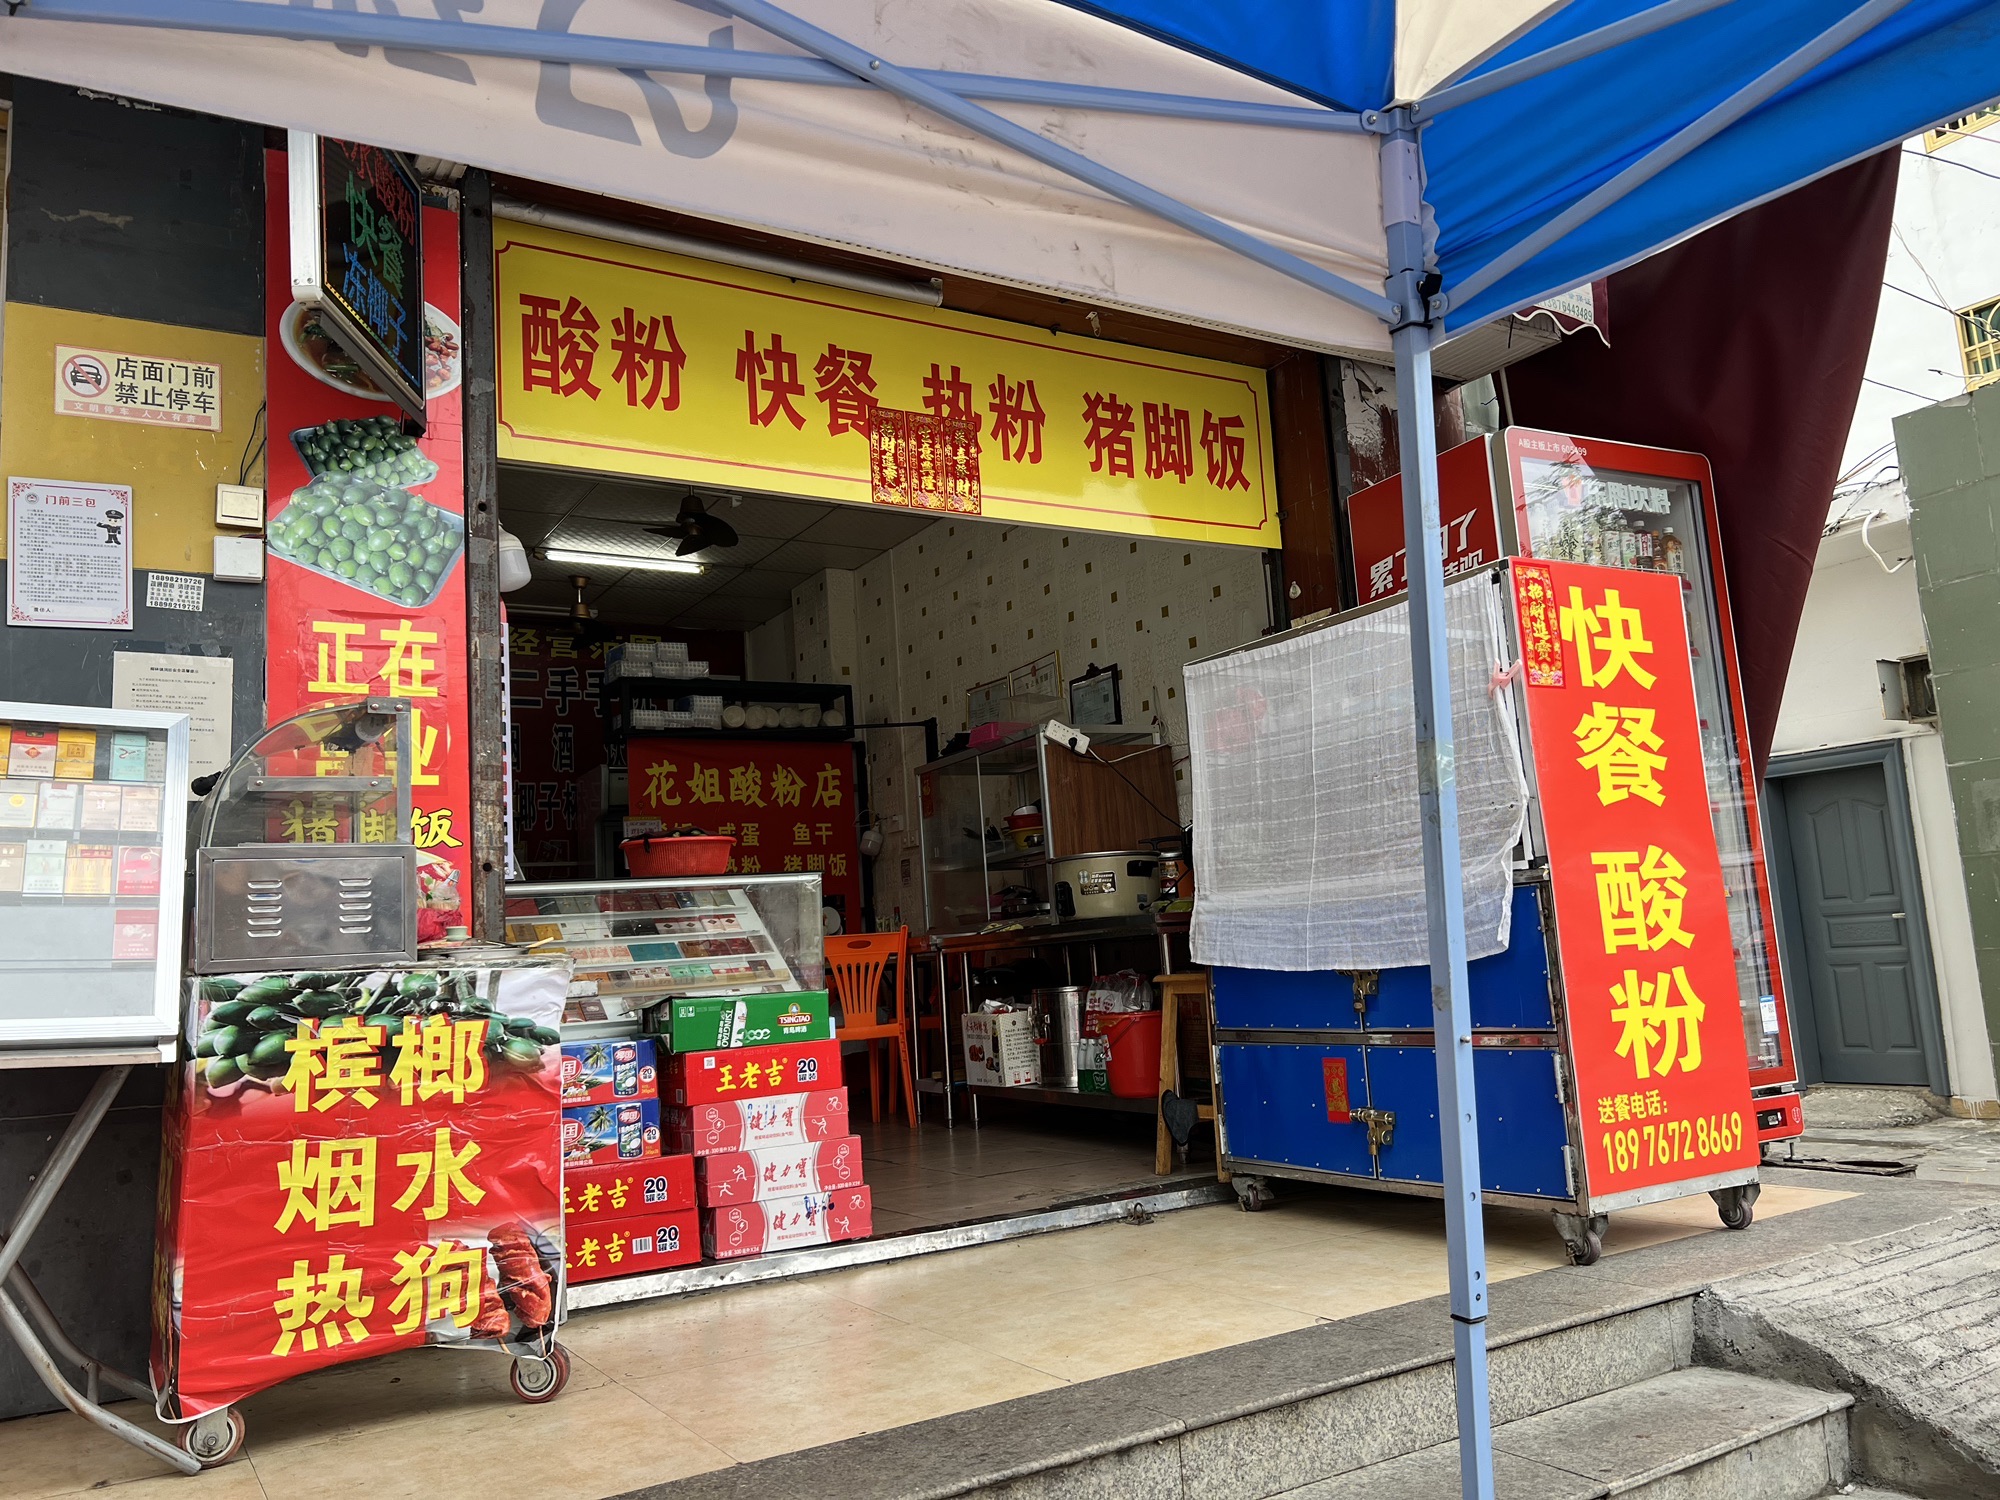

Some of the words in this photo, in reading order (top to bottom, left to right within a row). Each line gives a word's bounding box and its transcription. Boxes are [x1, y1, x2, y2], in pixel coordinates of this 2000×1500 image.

[346, 170, 405, 300] 快餐
[114, 357, 215, 389] 店面门前
[114, 382, 215, 413] 禁止停车
[520, 293, 687, 411] 酸粉
[735, 329, 878, 438] 快餐
[922, 361, 1046, 465] 热粉
[1081, 390, 1252, 493] 猪脚饭
[74, 402, 130, 416] 文明停车
[142, 409, 196, 423] 人人有责
[1518, 438, 1560, 453] A股主板上市
[1561, 445, 1588, 456] 605499
[45, 494, 96, 508] 门前三包
[151, 574, 203, 585] 18898219726
[149, 601, 201, 610] 18898219726
[308, 619, 439, 698] 正在
[1560, 585, 1669, 808] 快餐
[643, 759, 843, 808] 花姐酸粉店
[792, 822, 834, 846] 鱼干
[783, 852, 848, 877] 猪脚饭
[1590, 844, 1706, 1080] 酸粉
[721, 1009, 734, 1048] TSINGTAO
[778, 1014, 811, 1025] TSINGTAO
[783, 1026, 808, 1035] 青岛啤酒
[282, 1012, 490, 1113] 槟榔
[642, 1068, 653, 1076] 20
[797, 1058, 818, 1074] 20
[715, 1059, 785, 1093] 王老吉
[797, 1073, 818, 1082] 罐装
[1597, 1089, 1668, 1124] 送餐电话:
[646, 1128, 657, 1136] 20
[274, 1127, 487, 1235] 烟水
[644, 1176, 667, 1194] 20
[645, 1192, 667, 1203] 罐装
[657, 1226, 680, 1244] 20
[658, 1242, 679, 1252] 罐装
[271, 1240, 488, 1358] 热狗
